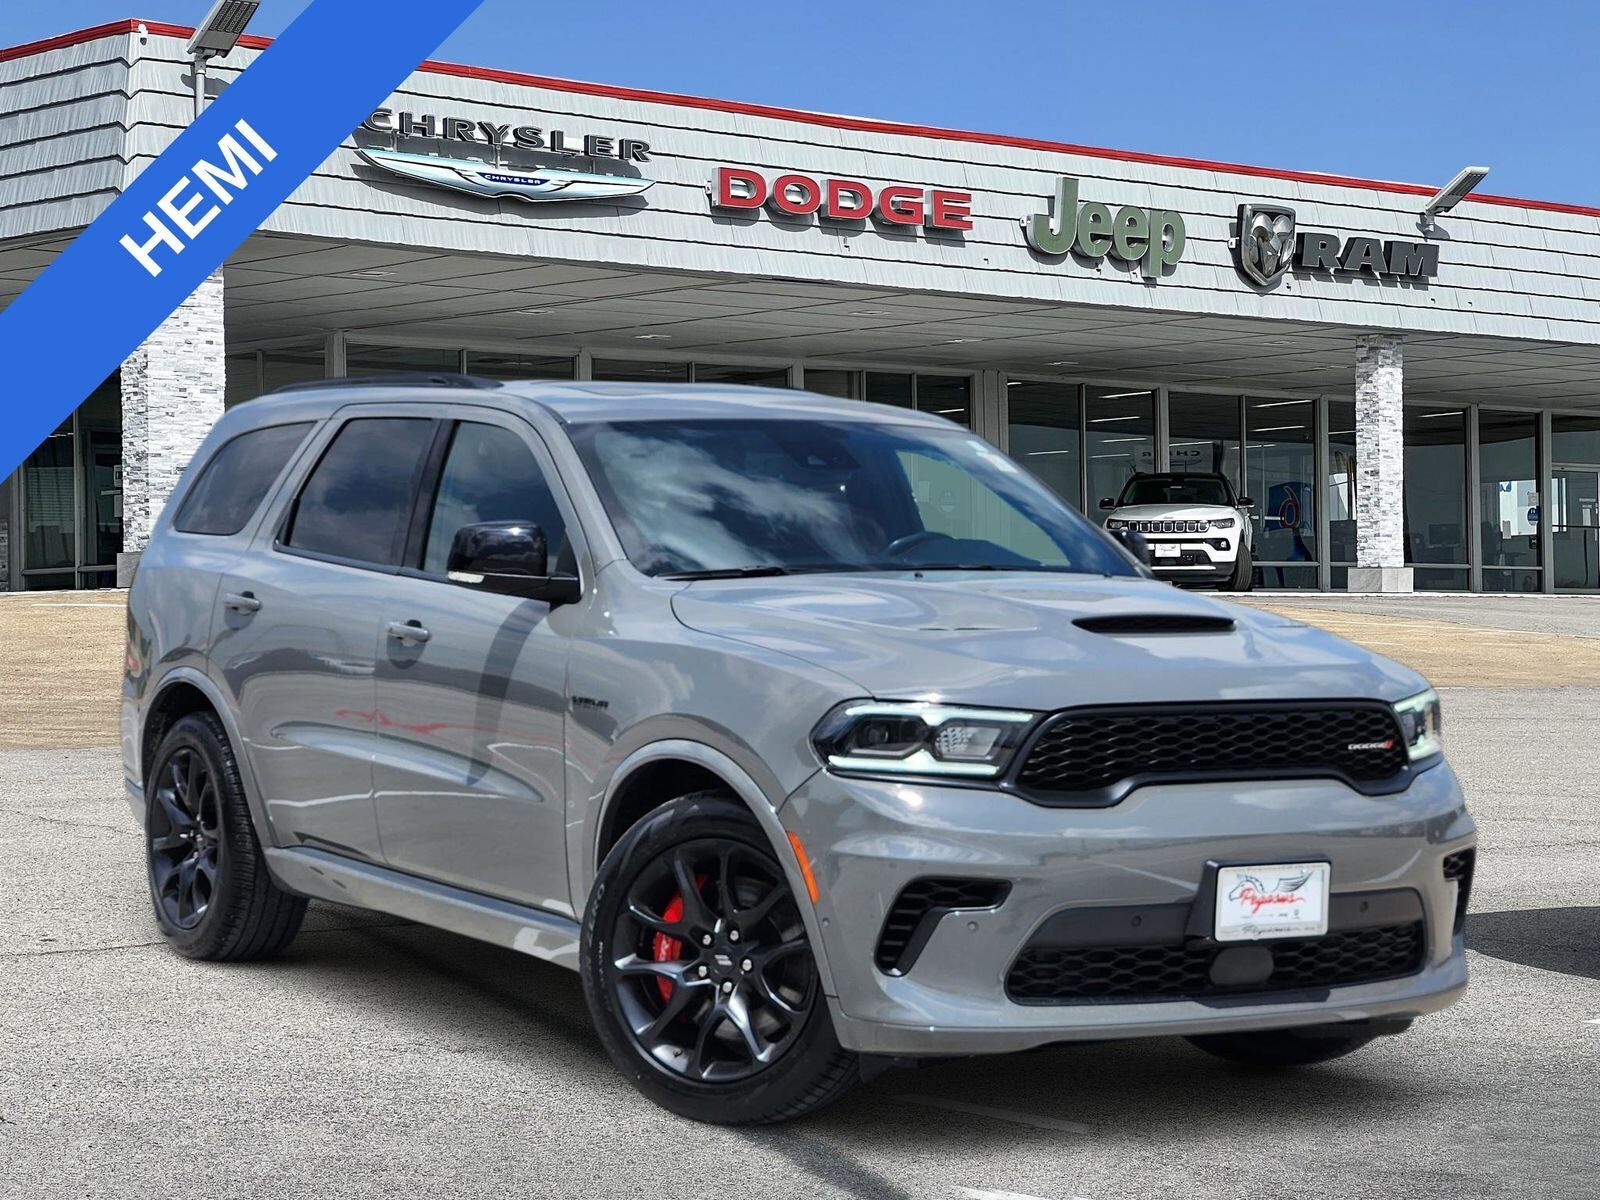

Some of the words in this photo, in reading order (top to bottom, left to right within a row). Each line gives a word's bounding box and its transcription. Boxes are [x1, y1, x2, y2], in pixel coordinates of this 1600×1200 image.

[362, 107, 652, 162] CHRYSLER
[484, 174, 541, 185] CHRYSLER
[713, 166, 973, 230] DODGE
[1027, 177, 1186, 278] Jeep
[1294, 232, 1440, 277] RAM
